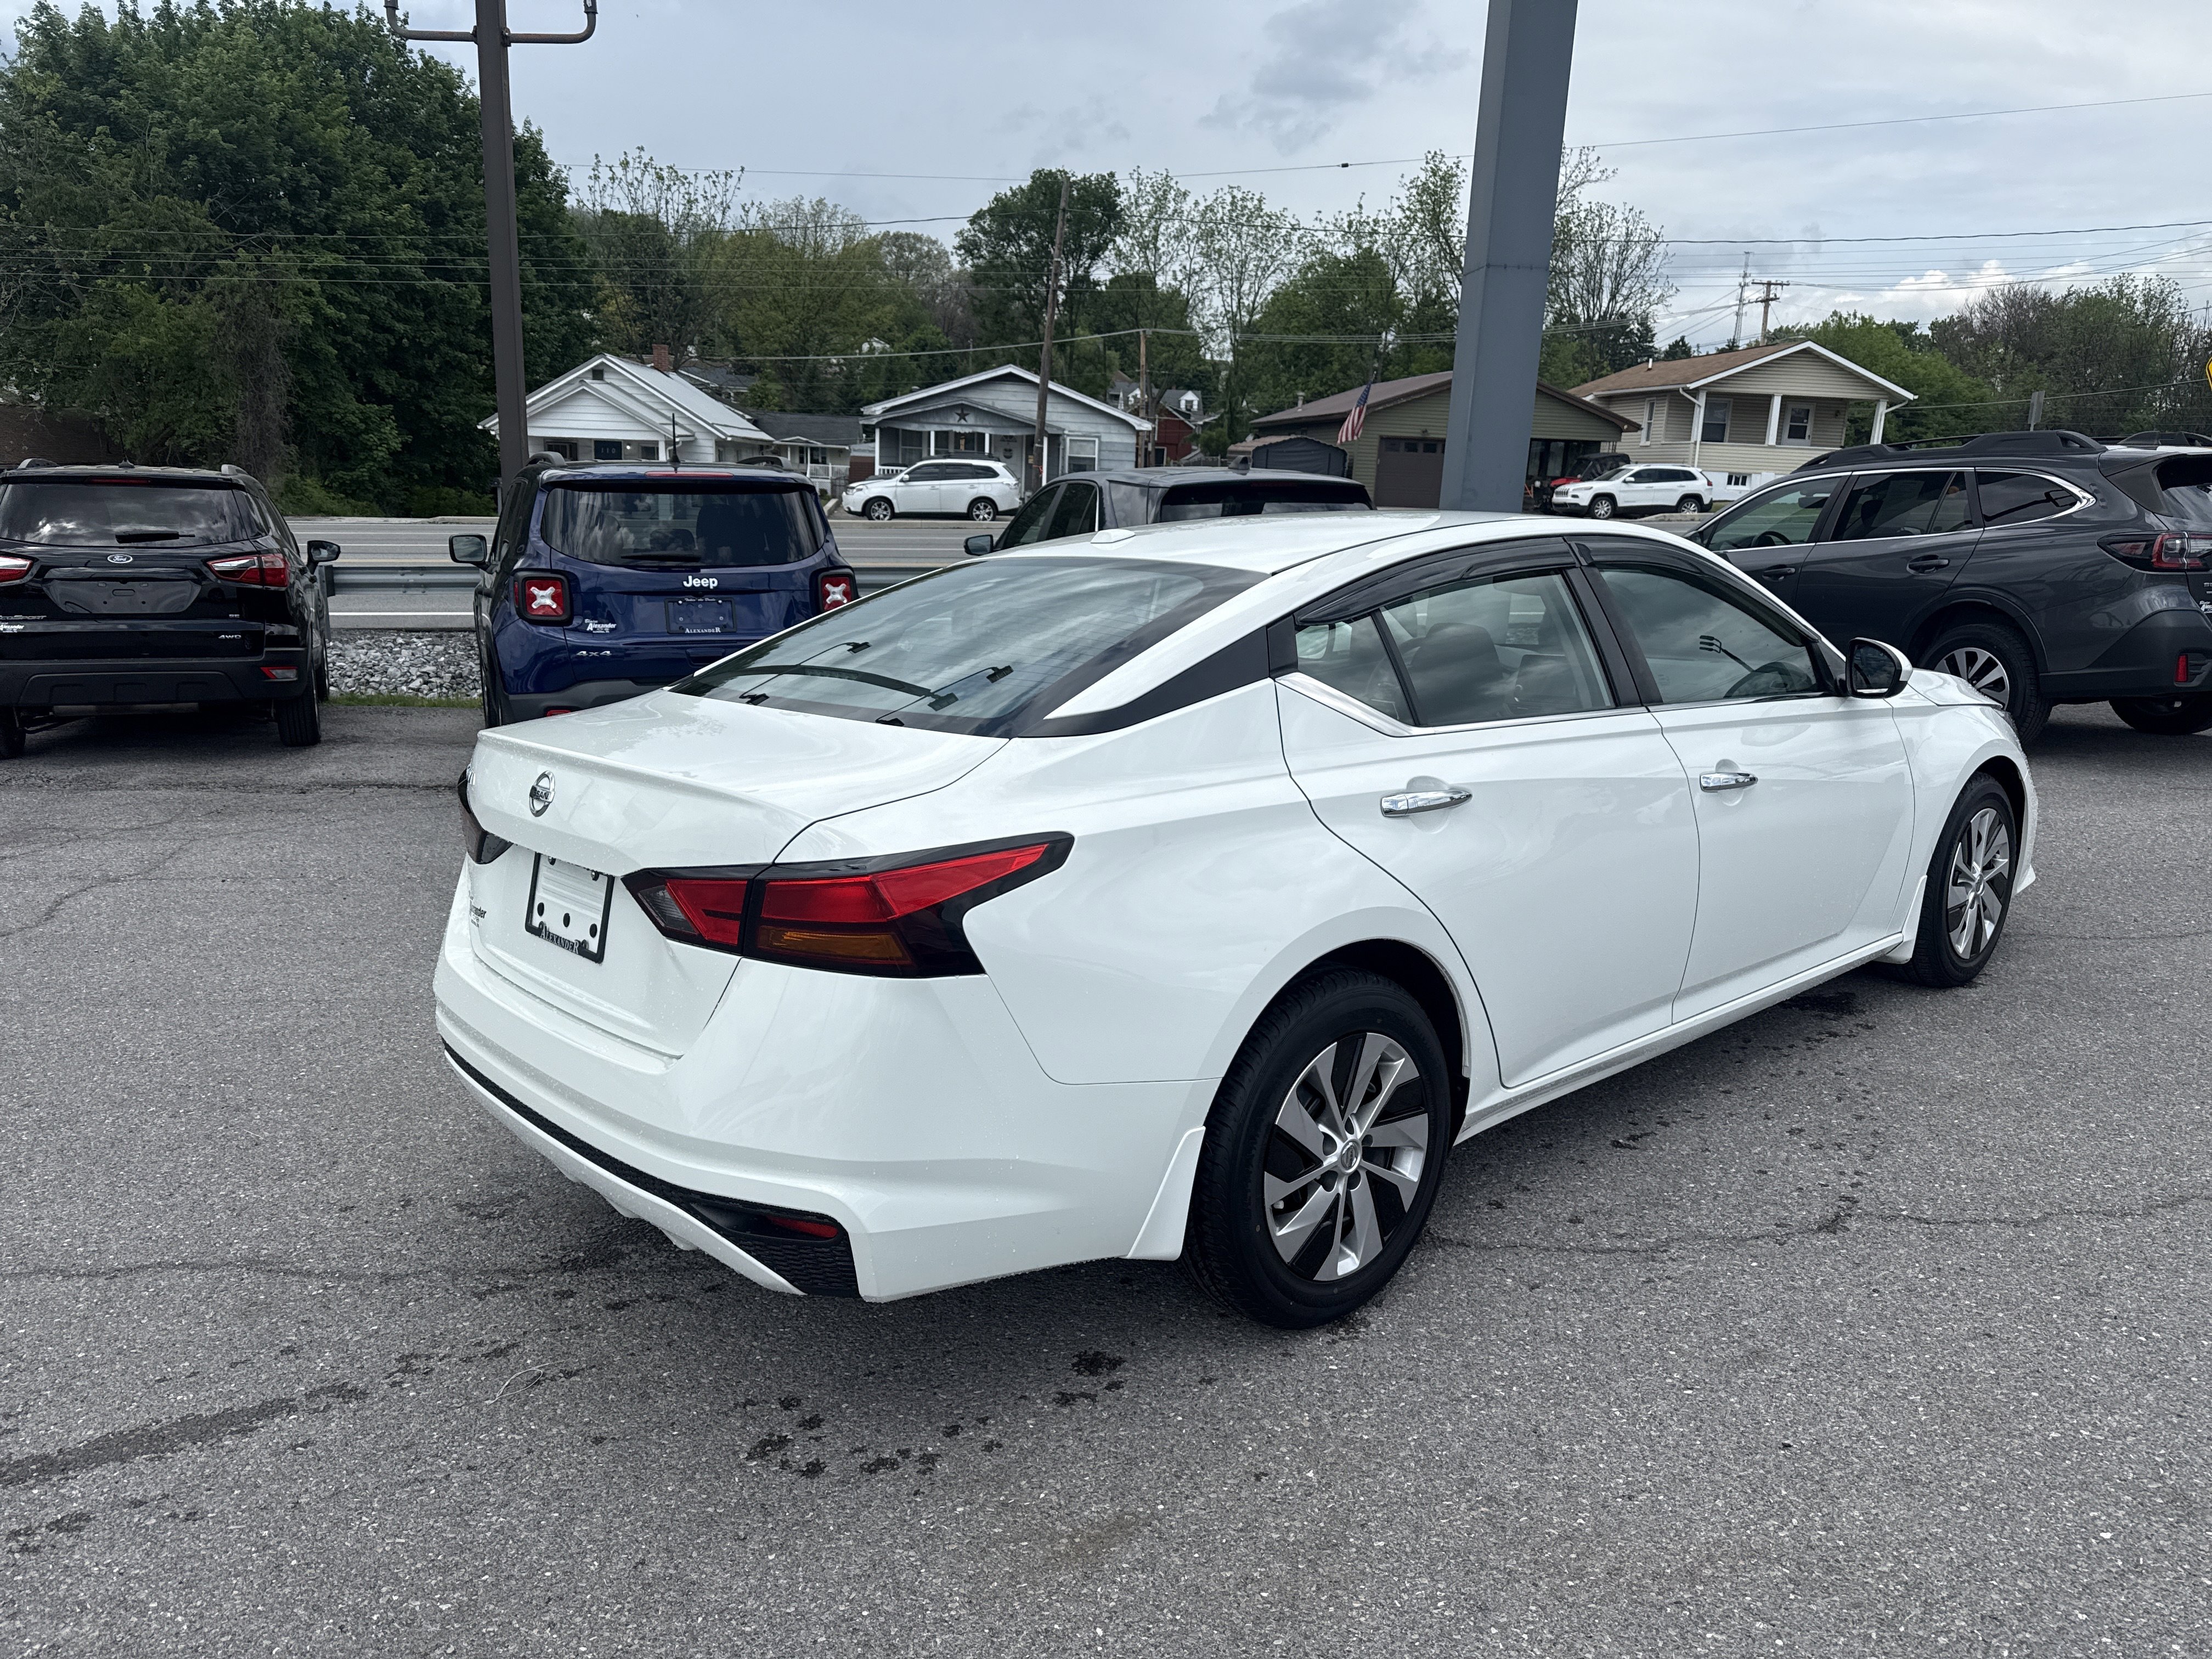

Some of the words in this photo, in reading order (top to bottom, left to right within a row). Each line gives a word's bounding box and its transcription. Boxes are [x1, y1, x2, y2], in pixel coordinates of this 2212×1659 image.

[683, 575, 718, 589] Jeep
[586, 623, 617, 631] Alexander
[540, 924, 579, 955] ALEXANDER
